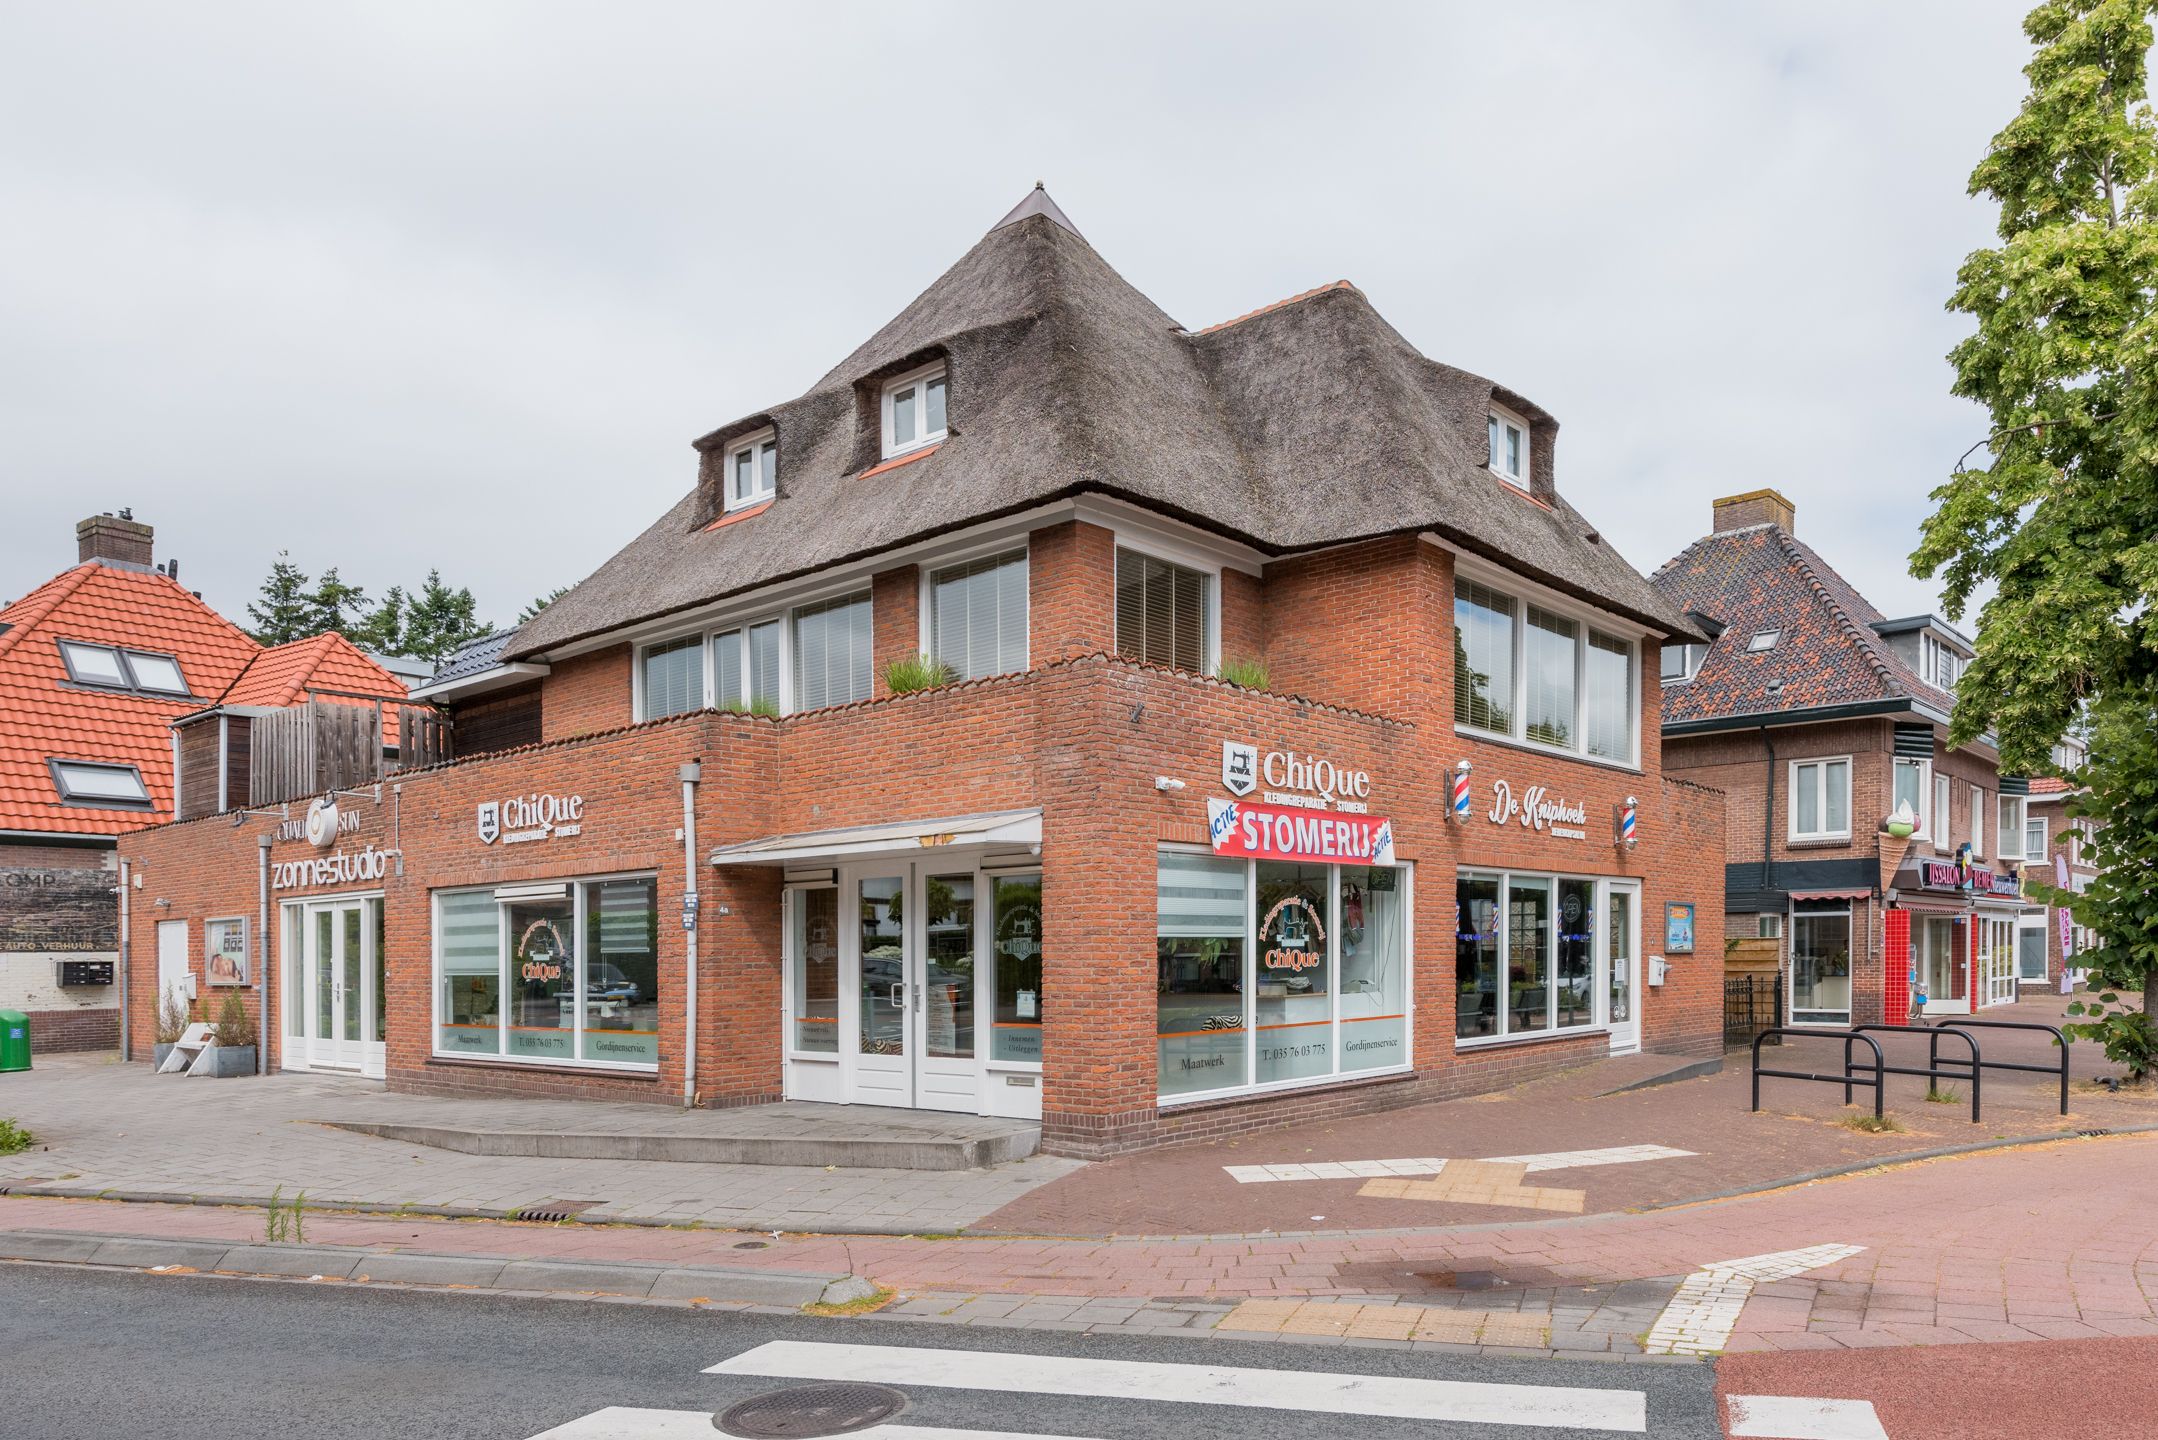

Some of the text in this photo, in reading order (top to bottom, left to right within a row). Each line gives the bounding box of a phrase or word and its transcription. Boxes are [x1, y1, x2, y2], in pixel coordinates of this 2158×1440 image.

[1263, 751, 1370, 803] ChiQue
[502, 793, 583, 831] ChiQue
[1336, 800, 1368, 814] STOMERIJ
[1488, 780, 1587, 830] De Kniphoek
[338, 810, 360, 832] SUN
[1210, 804, 1238, 839] ACTIE
[1242, 810, 1371, 858] STOMERIJ
[1373, 830, 1392, 860] ACTIE
[271, 845, 385, 889] zonnestudio
[1929, 863, 1961, 886] IJSSALON
[1265, 948, 1320, 972] ChiQue
[522, 962, 561, 983] ChiQue
[596, 1040, 646, 1053] Gordijnenservice
[1262, 1043, 1326, 1061] T. 035 76 03 775
[1345, 1036, 1398, 1052] Gordijnenservice
[1181, 1055, 1225, 1071] Maatwerk
